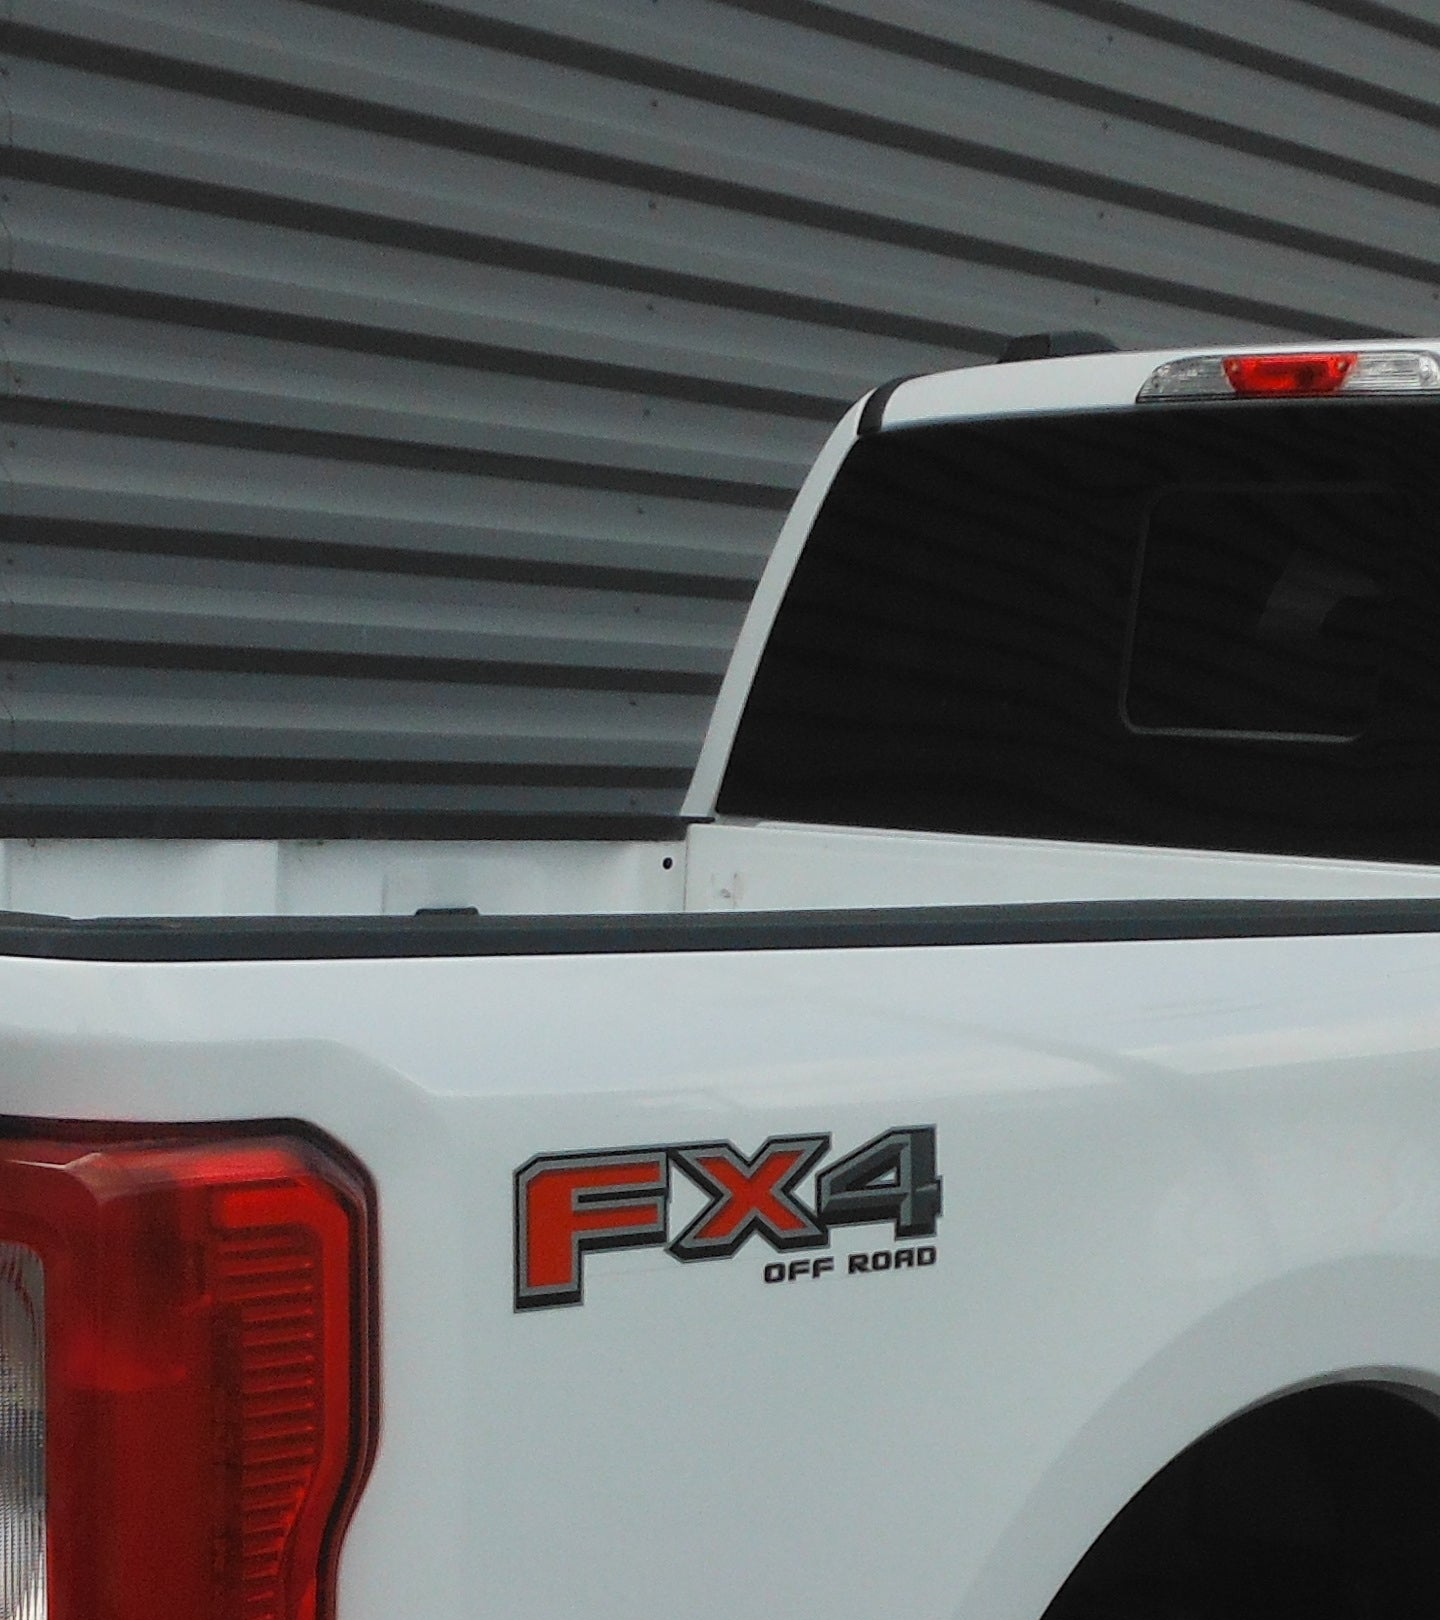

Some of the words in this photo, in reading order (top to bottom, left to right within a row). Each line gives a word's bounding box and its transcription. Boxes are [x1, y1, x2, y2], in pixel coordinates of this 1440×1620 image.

[512, 1122, 944, 1314] FX4
[763, 1254, 836, 1285] OFF
[847, 1245, 939, 1275] ROAD
